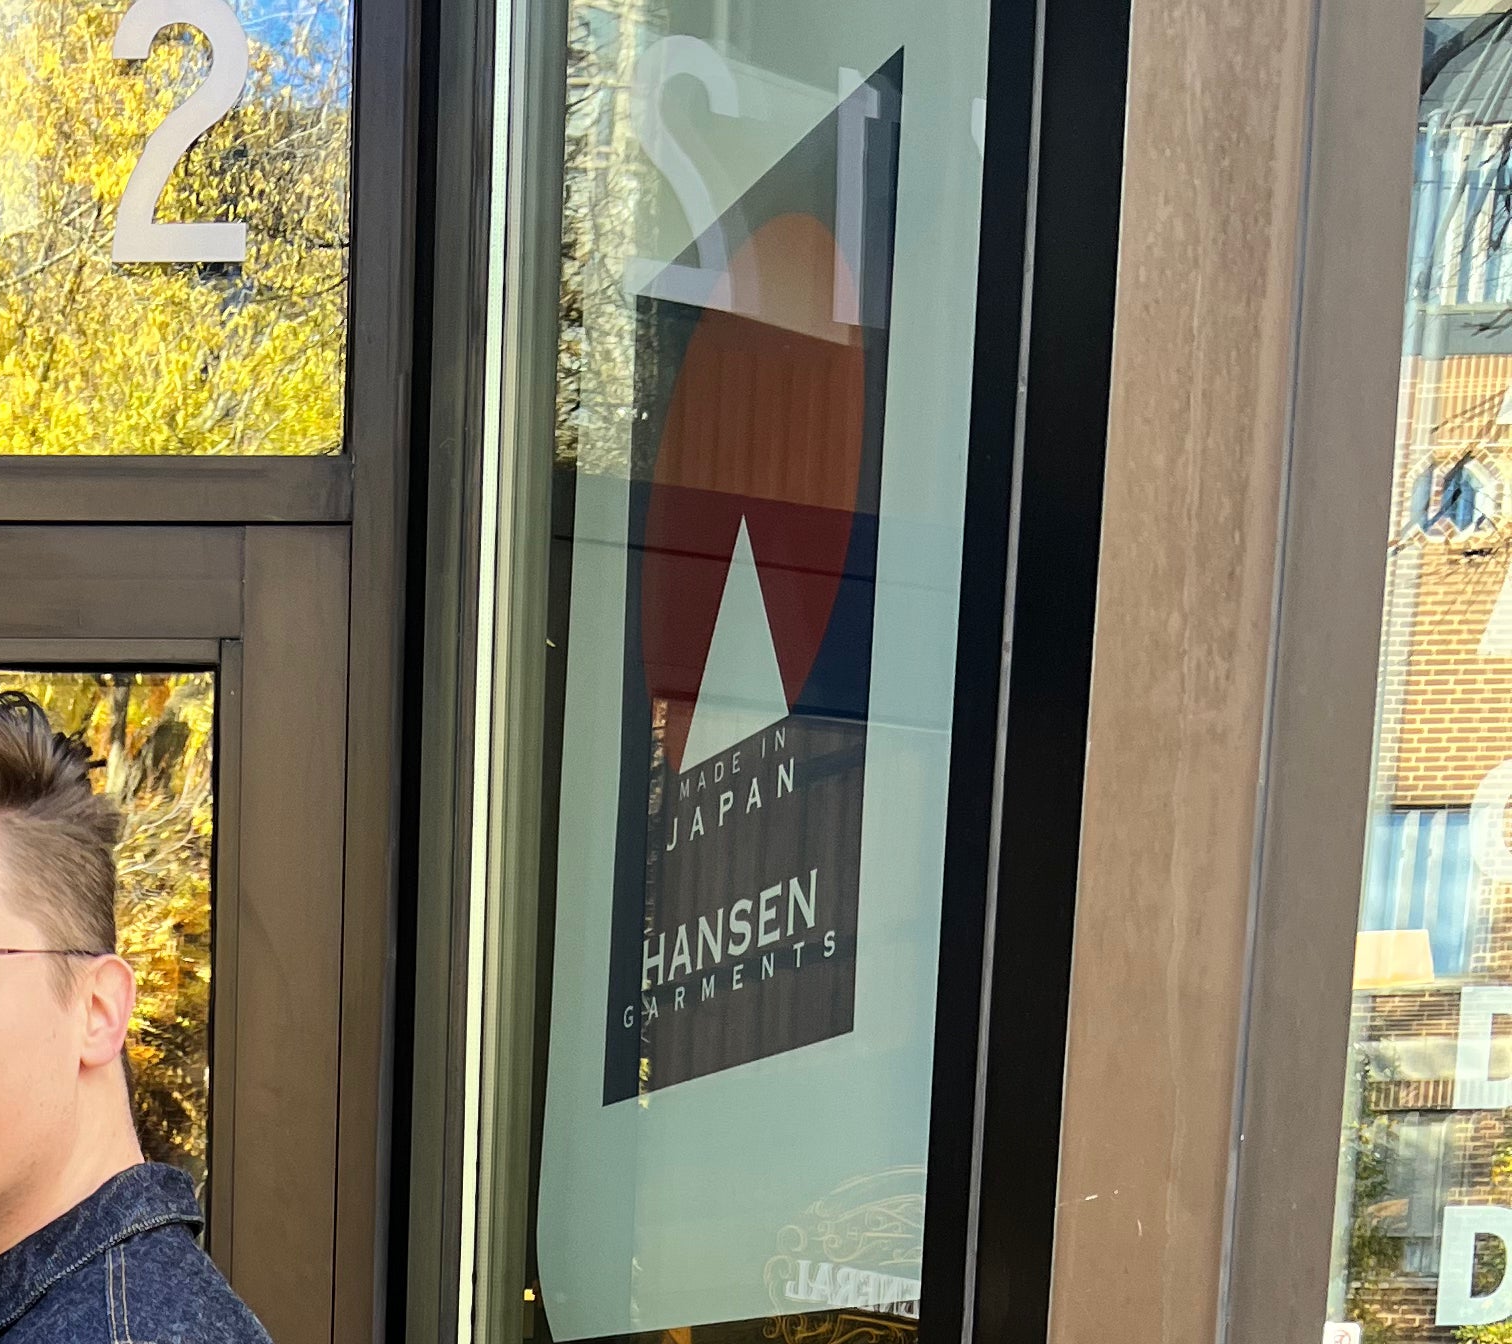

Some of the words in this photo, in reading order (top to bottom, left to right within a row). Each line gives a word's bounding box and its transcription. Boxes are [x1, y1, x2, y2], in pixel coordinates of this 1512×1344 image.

[666, 757, 796, 853] JAPAN
[679, 751, 741, 802] MADE
[761, 726, 787, 760] IN
[640, 868, 820, 992] HANSEN
[622, 929, 837, 1030] GARMENTS
